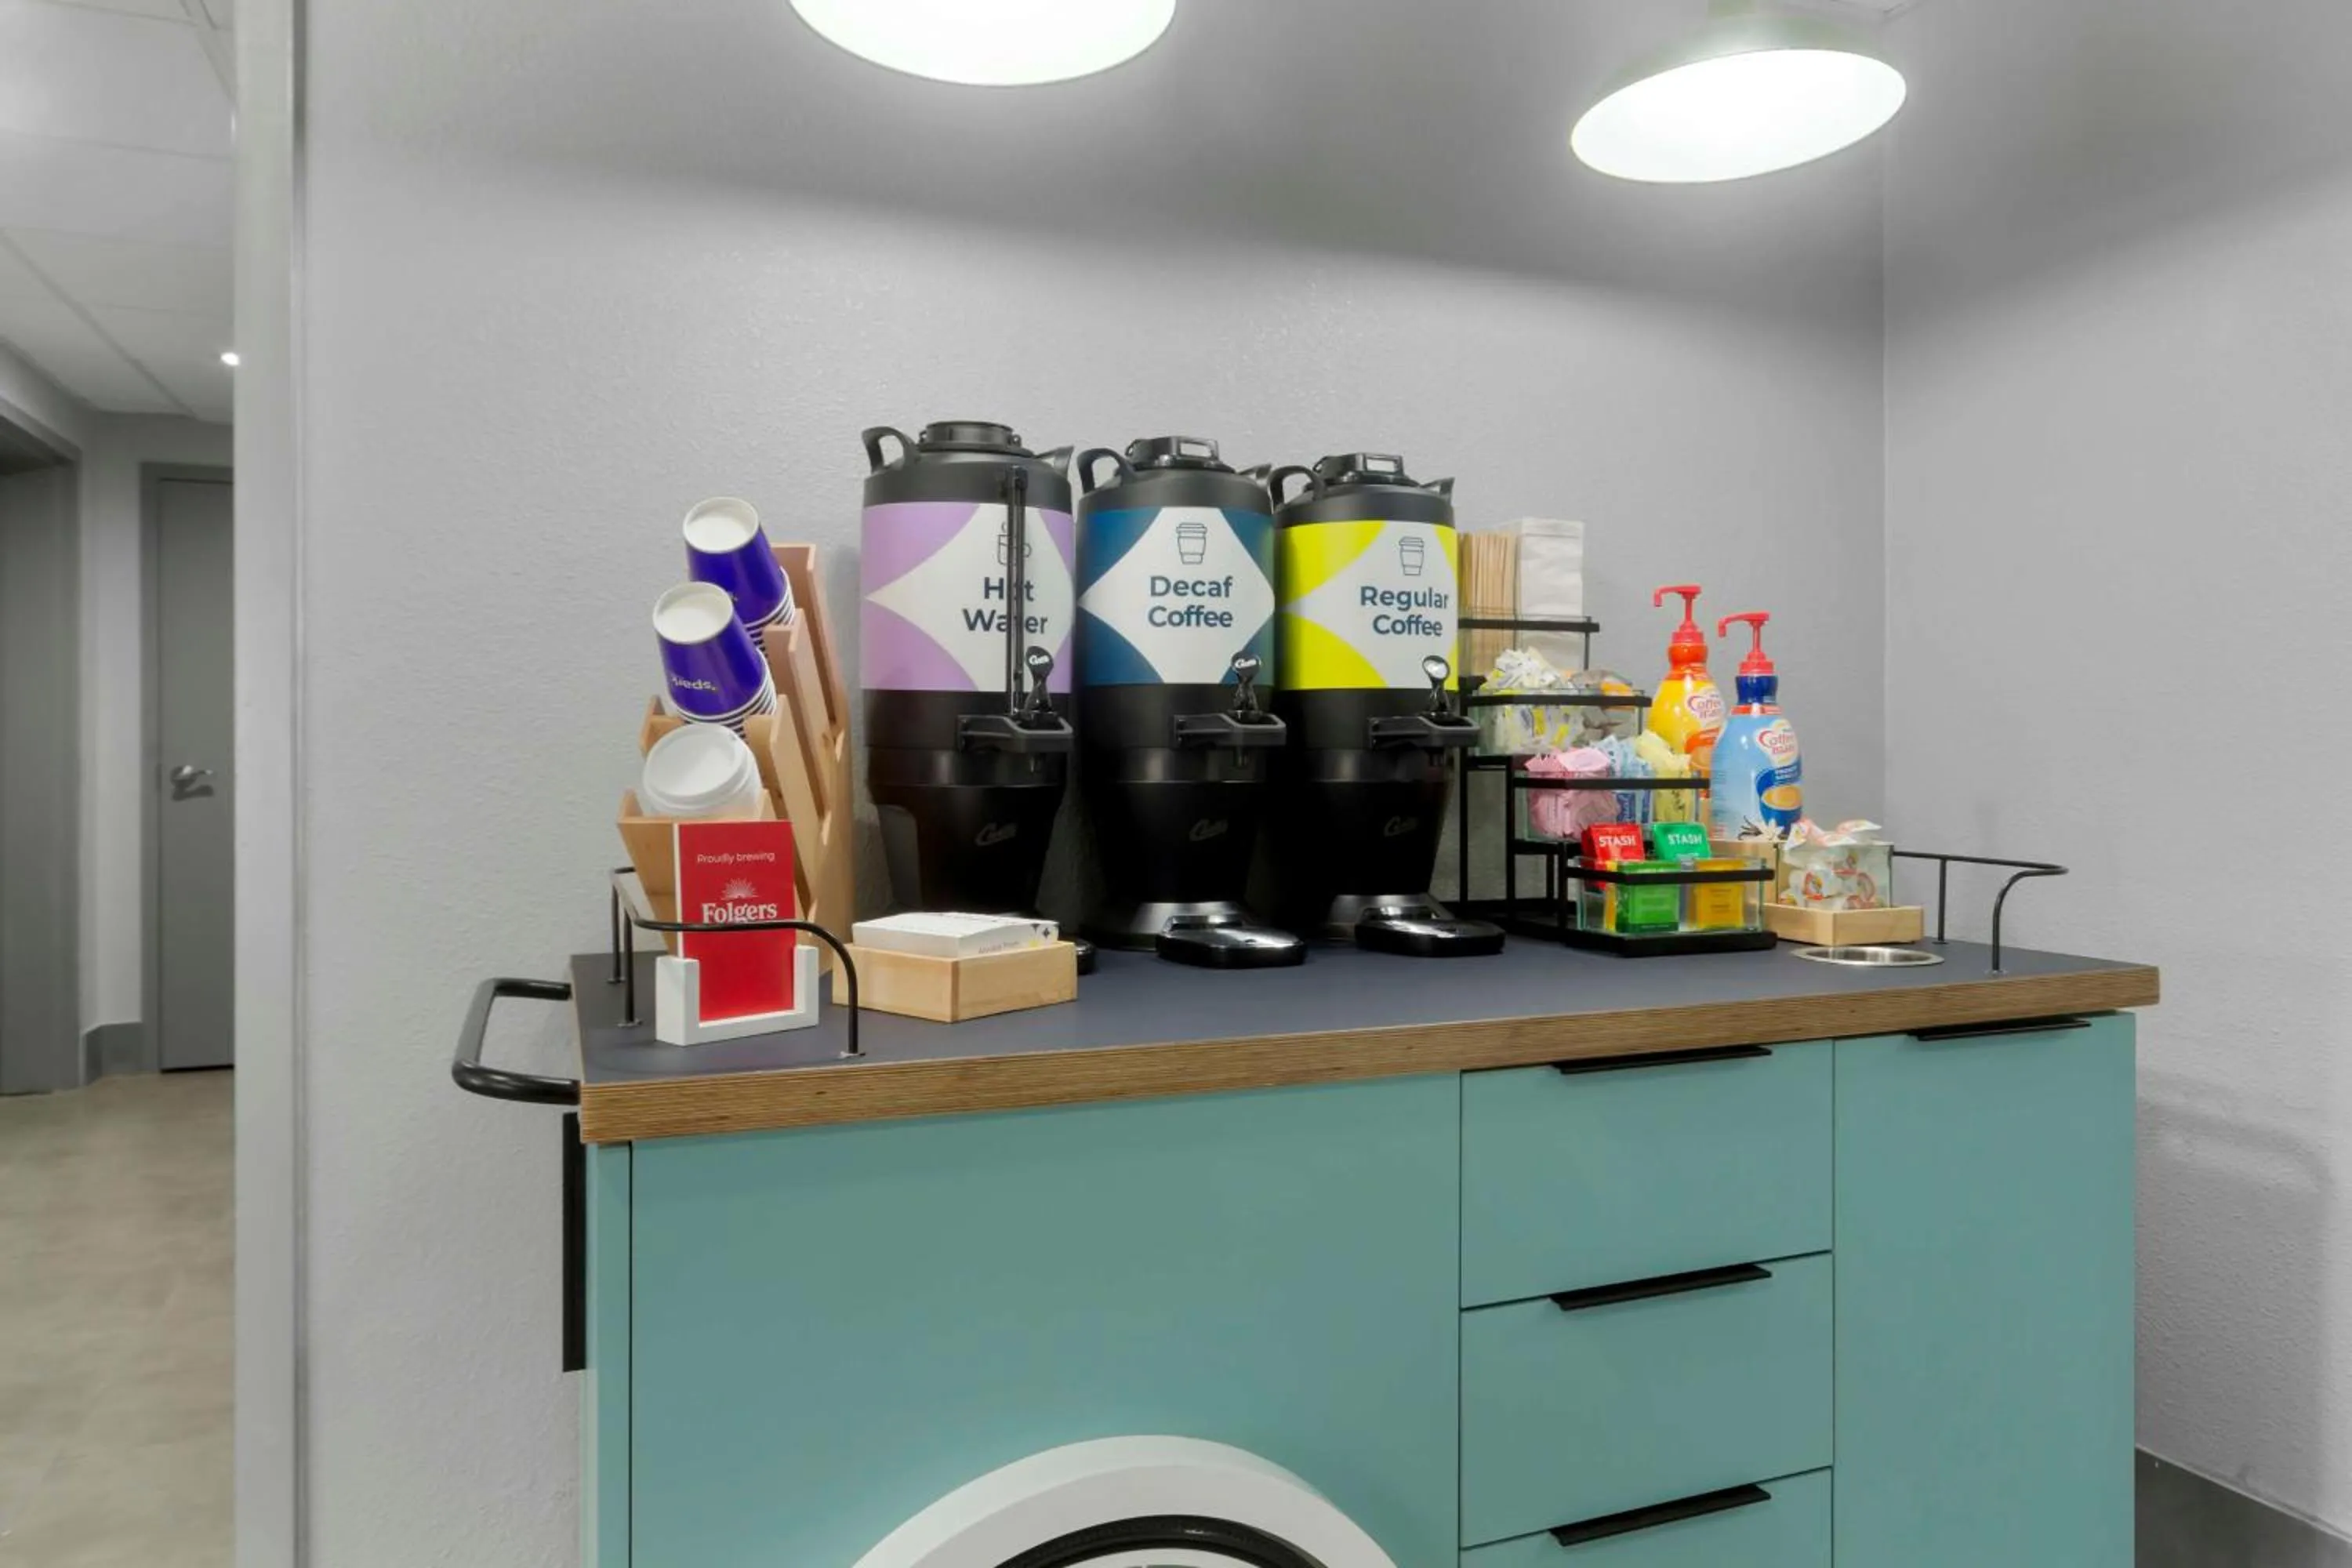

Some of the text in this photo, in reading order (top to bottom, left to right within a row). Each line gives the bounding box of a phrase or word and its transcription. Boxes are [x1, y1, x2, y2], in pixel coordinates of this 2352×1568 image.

[983, 576, 1035, 602] Ht
[1149, 575, 1233, 598] Decaf
[1359, 585, 1448, 612] Regular
[962, 608, 1047, 635] Waer
[1148, 604, 1233, 628] Coffee
[1372, 613, 1443, 637] Coffee
[1599, 834, 1636, 847] STASH
[1668, 833, 1702, 845] STASH
[697, 851, 775, 865] Proudly brewing
[702, 902, 779, 924] Folgers
